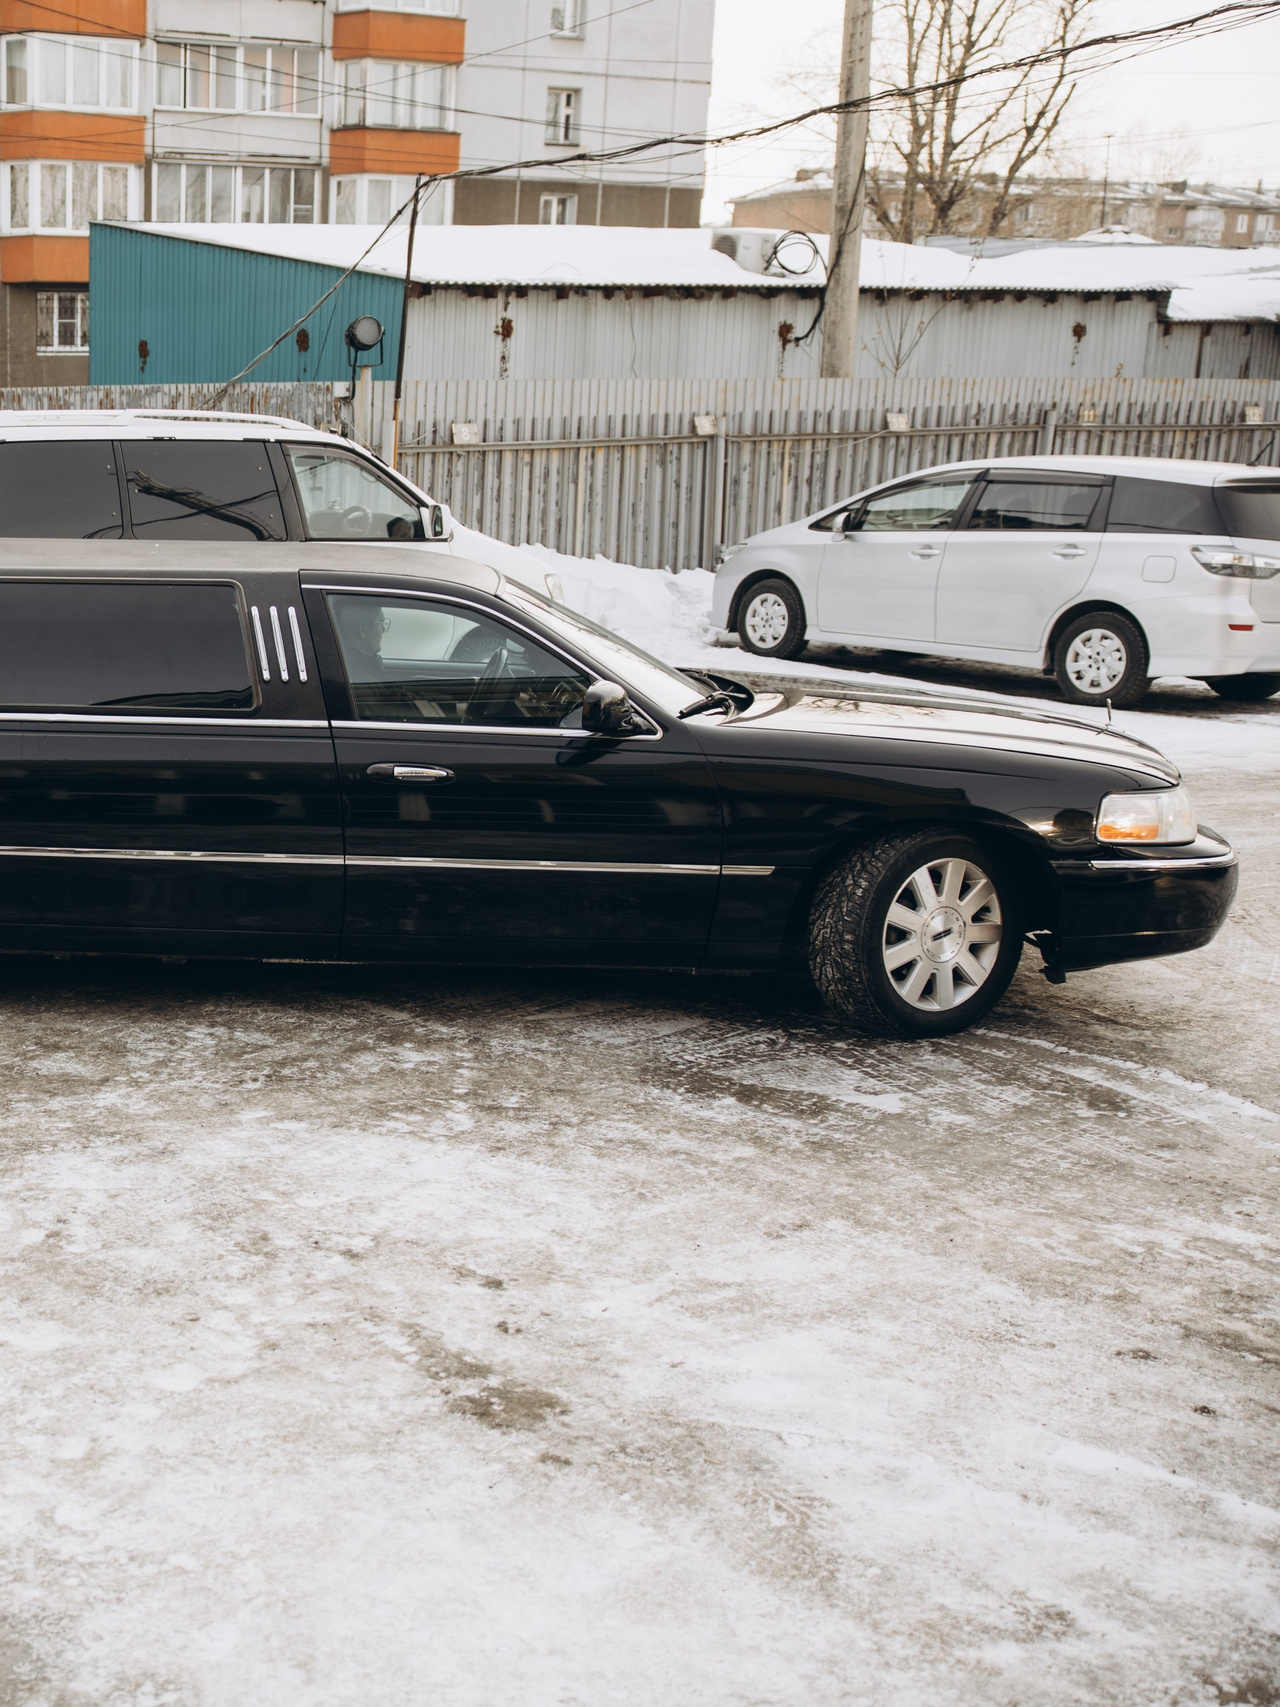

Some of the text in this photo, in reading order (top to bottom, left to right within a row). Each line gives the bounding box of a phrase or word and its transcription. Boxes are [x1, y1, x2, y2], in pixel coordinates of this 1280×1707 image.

[1083, 409, 1095, 422] 11
[702, 419, 710, 431] 9
[893, 416, 906, 429] 10
[462, 427, 470, 441] 8
